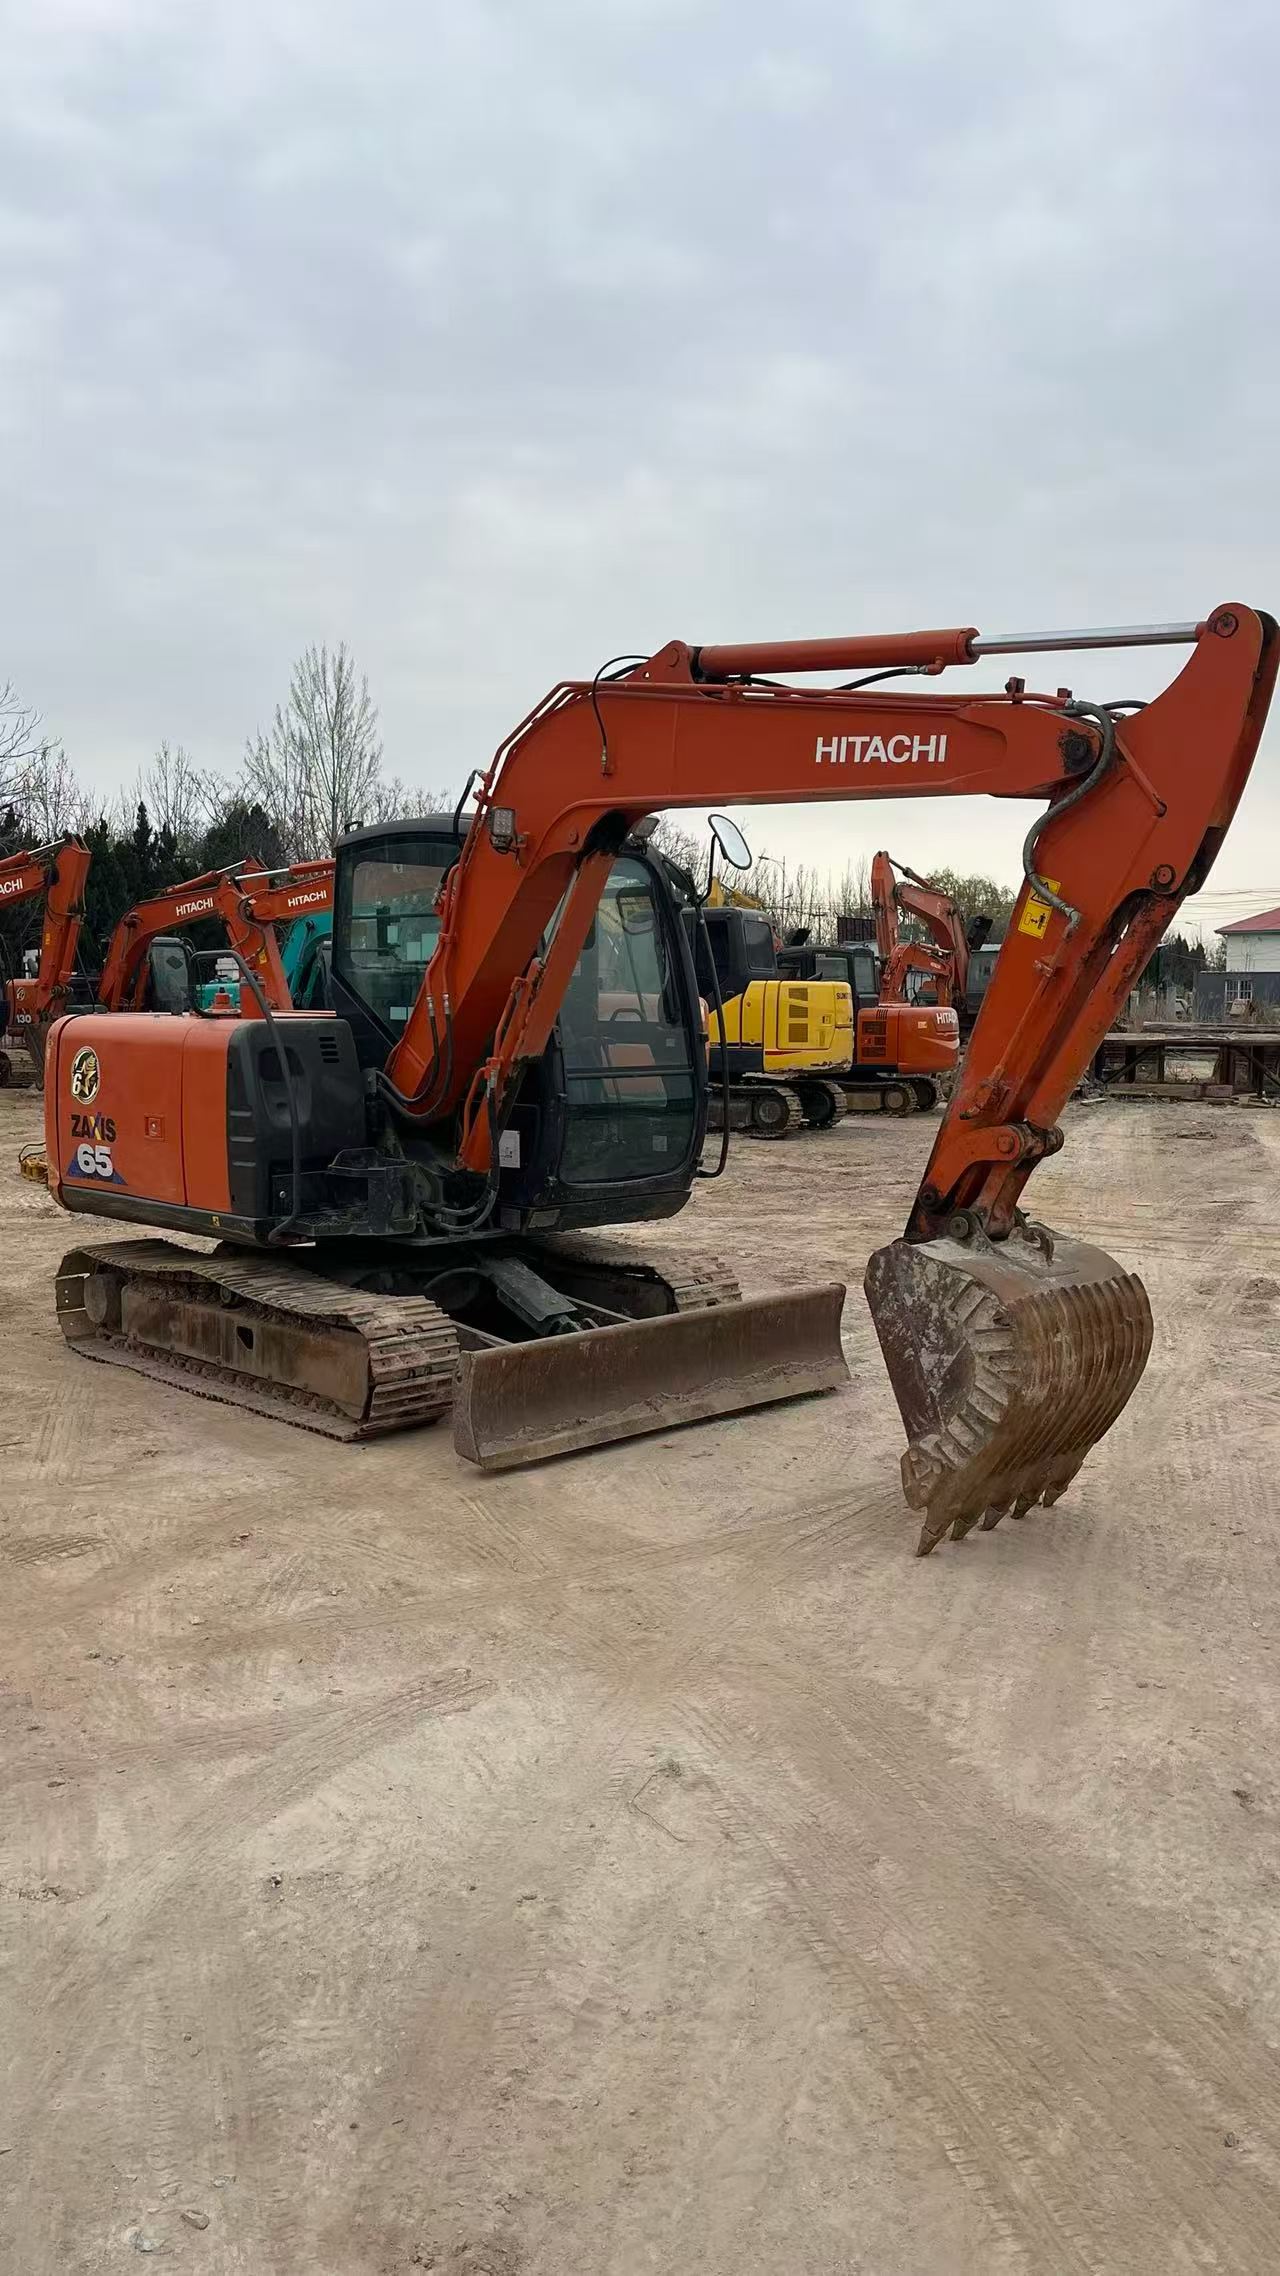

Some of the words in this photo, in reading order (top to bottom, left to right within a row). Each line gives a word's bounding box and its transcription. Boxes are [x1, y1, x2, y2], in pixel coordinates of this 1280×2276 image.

[815, 734, 948, 763] HITACHI
[175, 897, 214, 917] HITACHI
[287, 889, 327, 908] HITACHI
[16, 1014, 32, 1024] 130
[71, 1112, 117, 1143] ZAXIS
[77, 1143, 113, 1177] 65
